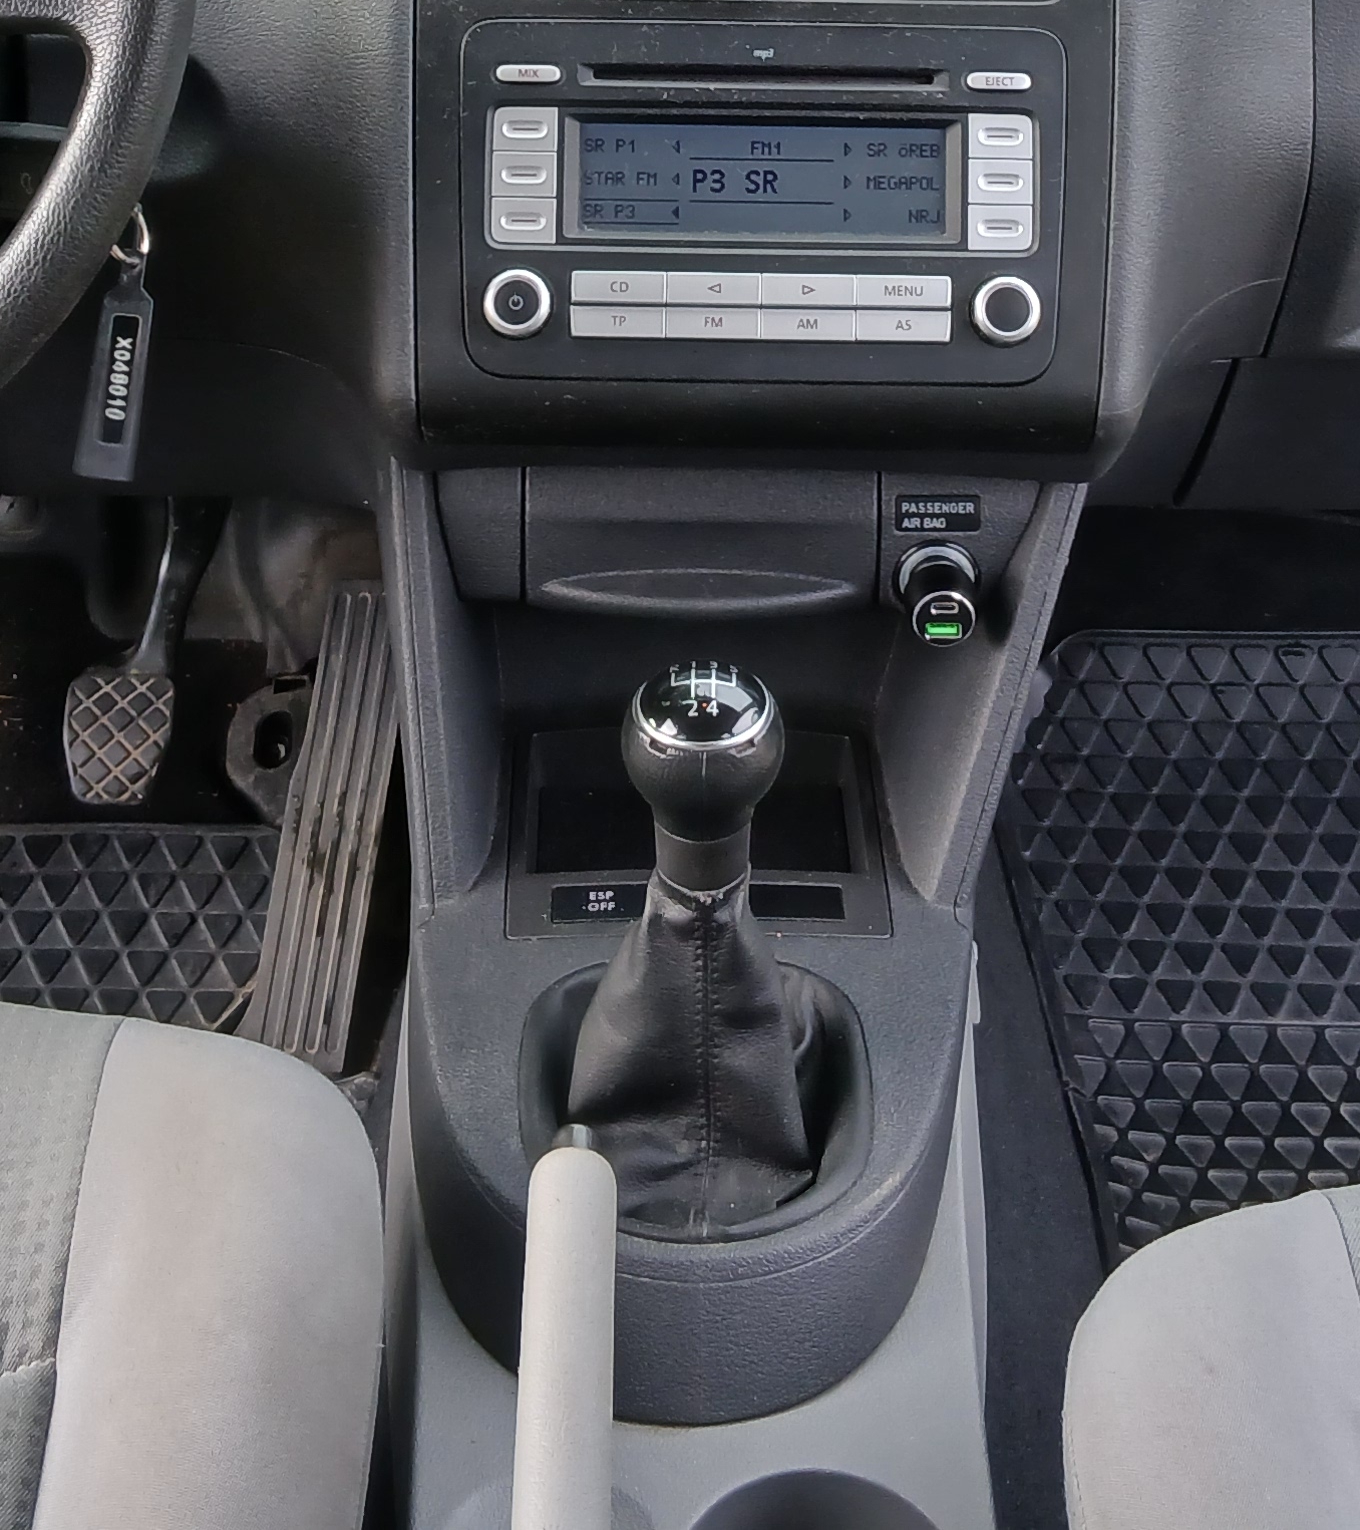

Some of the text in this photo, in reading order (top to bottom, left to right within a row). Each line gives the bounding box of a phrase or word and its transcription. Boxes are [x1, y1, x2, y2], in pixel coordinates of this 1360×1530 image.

[517, 69, 540, 78] MIX
[985, 76, 1015, 86] EJECT
[584, 138, 636, 153] SR P1
[750, 140, 782, 156] FM1
[866, 143, 888, 158] SR
[583, 171, 658, 187] STAR FM
[692, 168, 779, 195] P3 SR
[866, 175, 940, 191] MEGAPOL
[583, 203, 636, 219] SR P3
[908, 209, 940, 224] NRJ
[610, 281, 630, 293] CD
[883, 285, 924, 297] MENU
[611, 315, 627, 327] TP
[704, 317, 723, 328] FM
[796, 319, 818, 330] AM
[895, 320, 912, 331] AS
[901, 502, 975, 514] PASSENGER
[901, 518, 947, 529] AIR BAG
[685, 700, 699, 717] 2
[705, 700, 720, 717] 4
[589, 890, 615, 900] ESP
[587, 901, 617, 912] OFF
